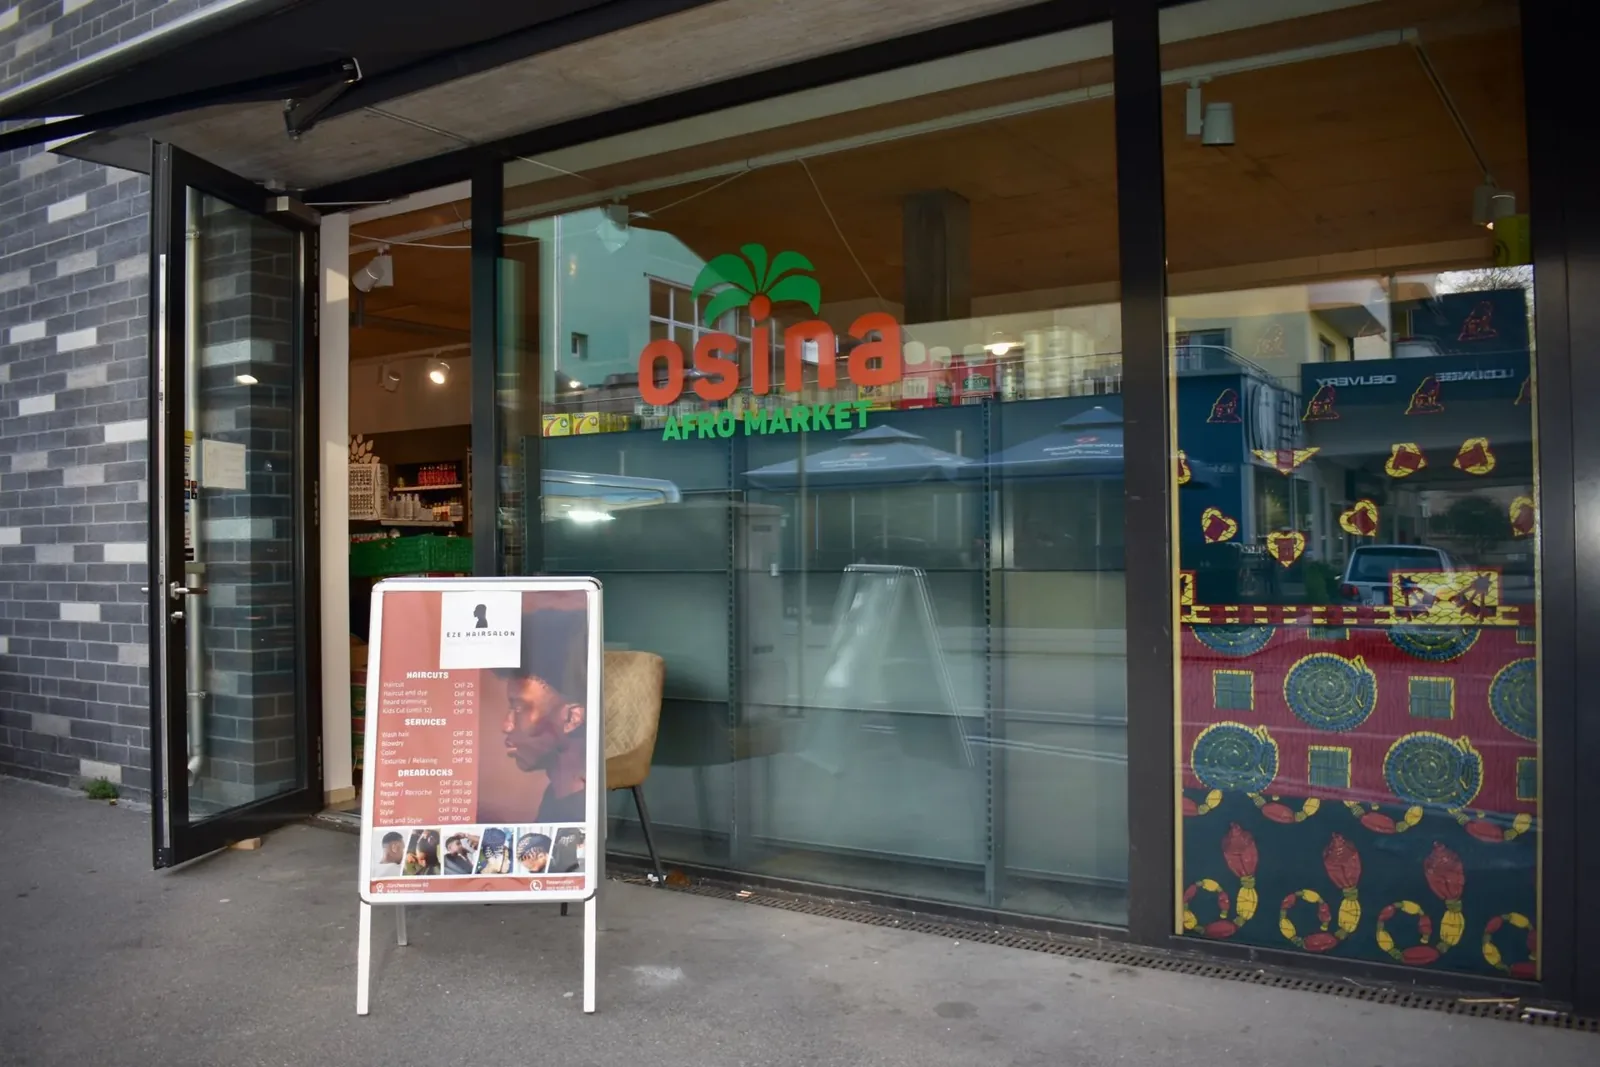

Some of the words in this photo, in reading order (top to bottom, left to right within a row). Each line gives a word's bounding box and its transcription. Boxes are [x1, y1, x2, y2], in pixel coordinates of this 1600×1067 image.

[638, 296, 902, 406] osina
[662, 408, 735, 441] AFRO
[744, 400, 872, 436] MARKET
[406, 671, 449, 679] HAIRCUTS
[404, 718, 447, 726] SERVICES
[397, 768, 454, 777] DREADLOCKS
